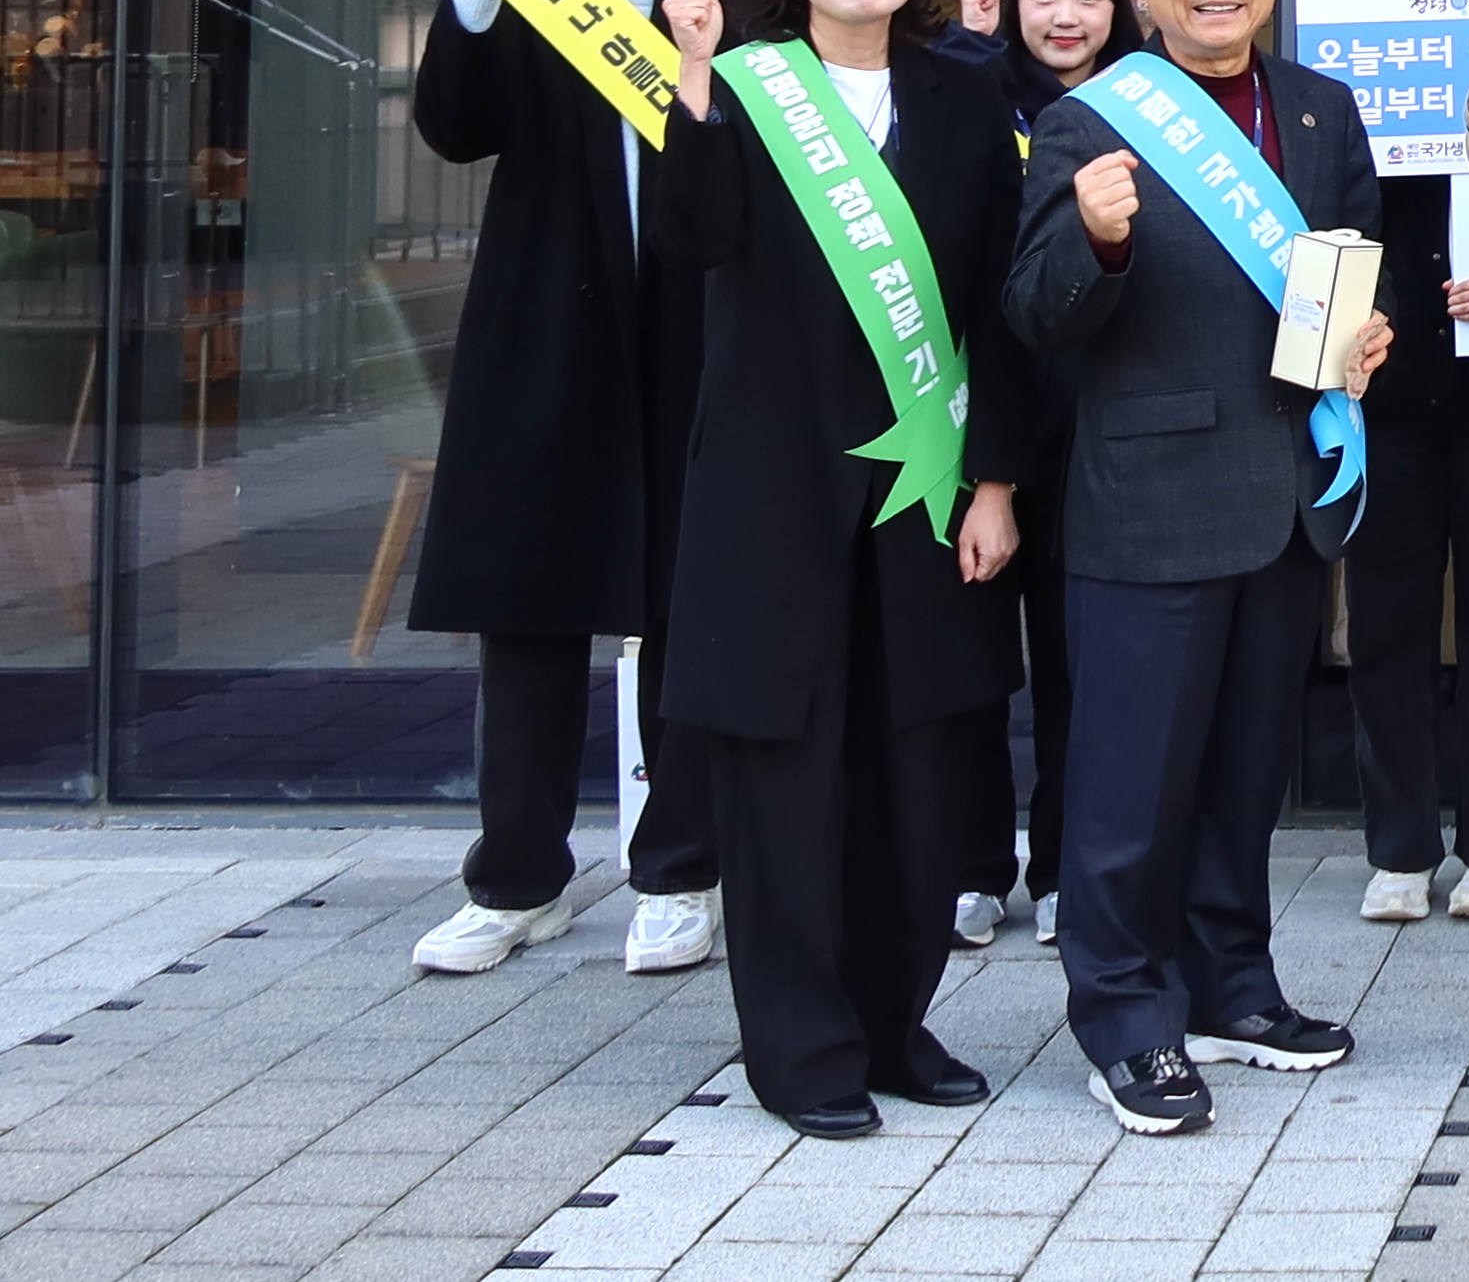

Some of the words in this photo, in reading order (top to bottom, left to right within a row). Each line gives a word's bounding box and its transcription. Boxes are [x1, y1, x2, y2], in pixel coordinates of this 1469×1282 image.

[1312, 35, 1453, 76] 오늘부터
[1109, 71, 1206, 156] 청렴한
[1420, 141, 1464, 157] 국가생
[826, 174, 894, 254] 정책
[869, 258, 926, 343] 전문
